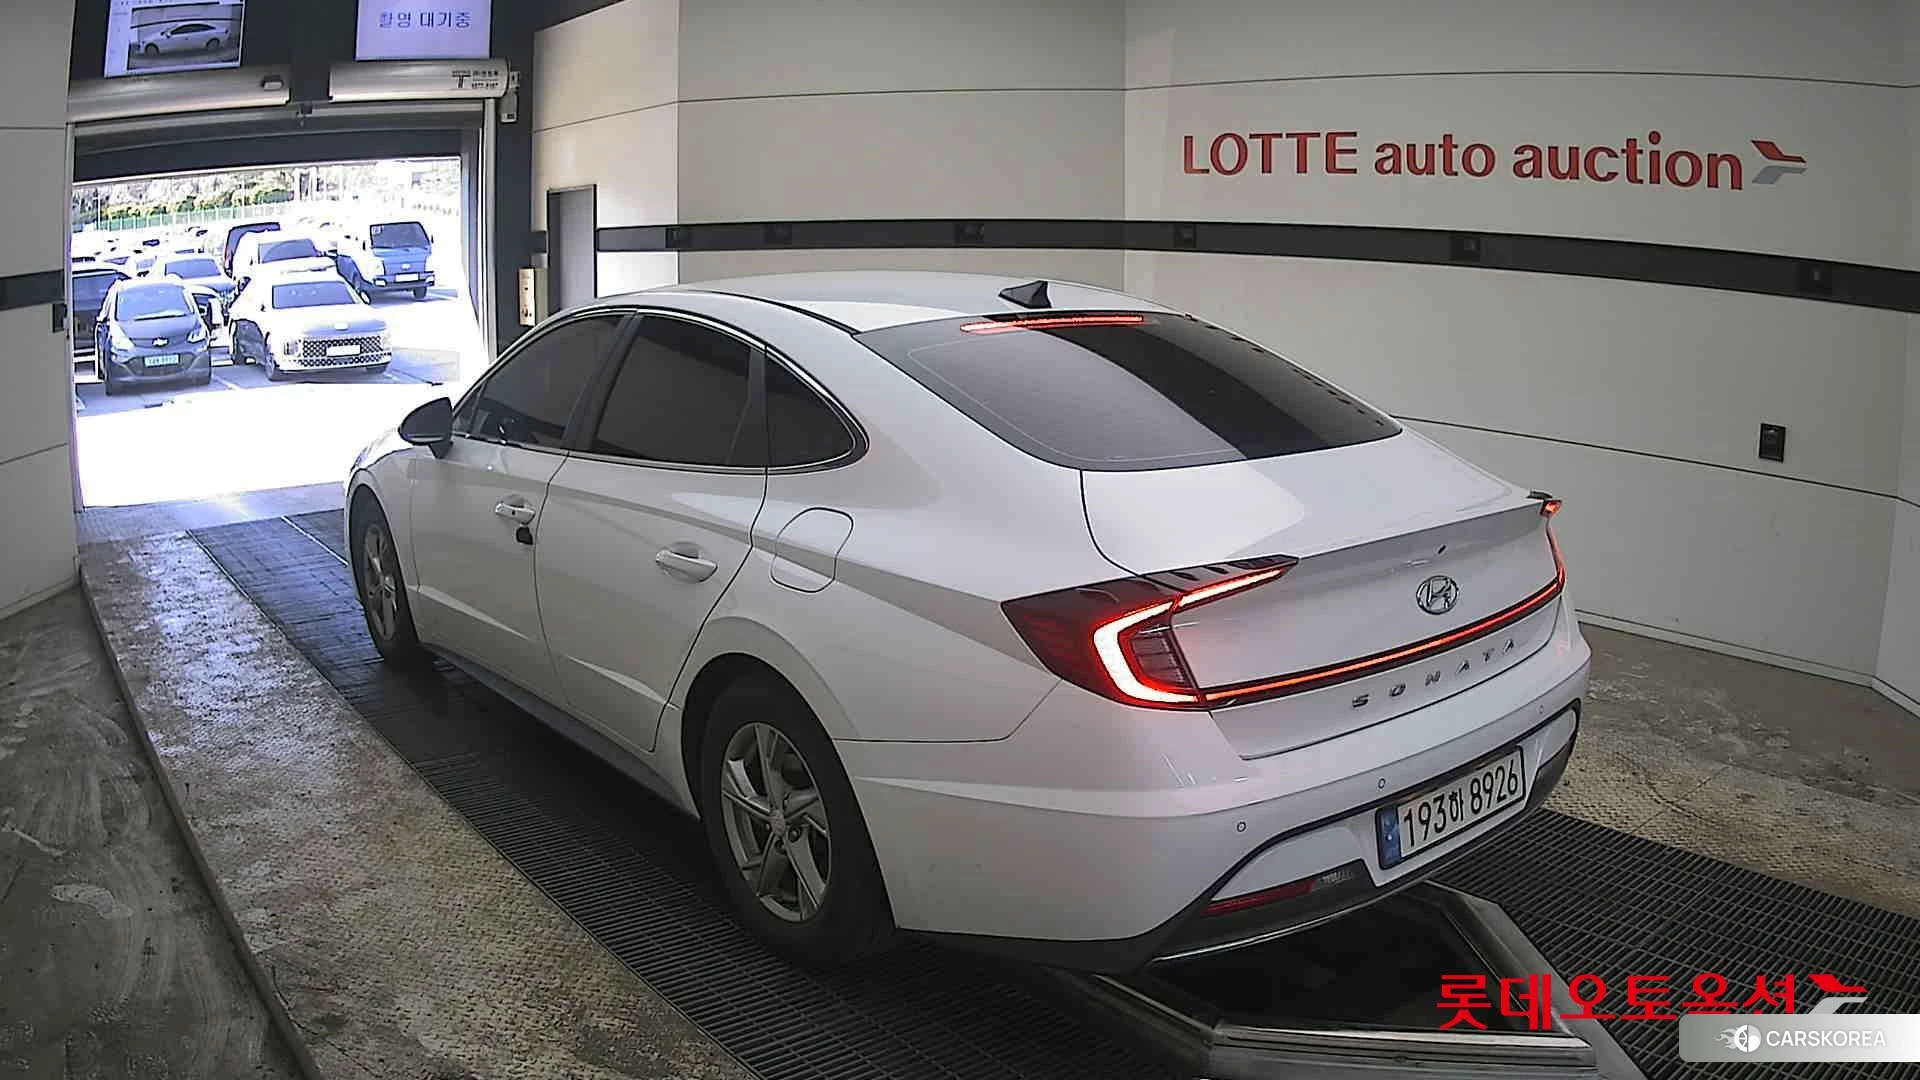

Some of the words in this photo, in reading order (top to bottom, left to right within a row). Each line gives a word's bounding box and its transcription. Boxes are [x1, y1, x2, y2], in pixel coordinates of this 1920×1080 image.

[420, 12, 470, 28] 대기중
[1183, 131, 1358, 176] LOTTE
[1375, 134, 1496, 177] auto
[1512, 130, 1742, 189] auction
[1352, 638, 1515, 708] SONATA
[1403, 787, 1464, 847] 193하
[1470, 759, 1518, 815] 8926
